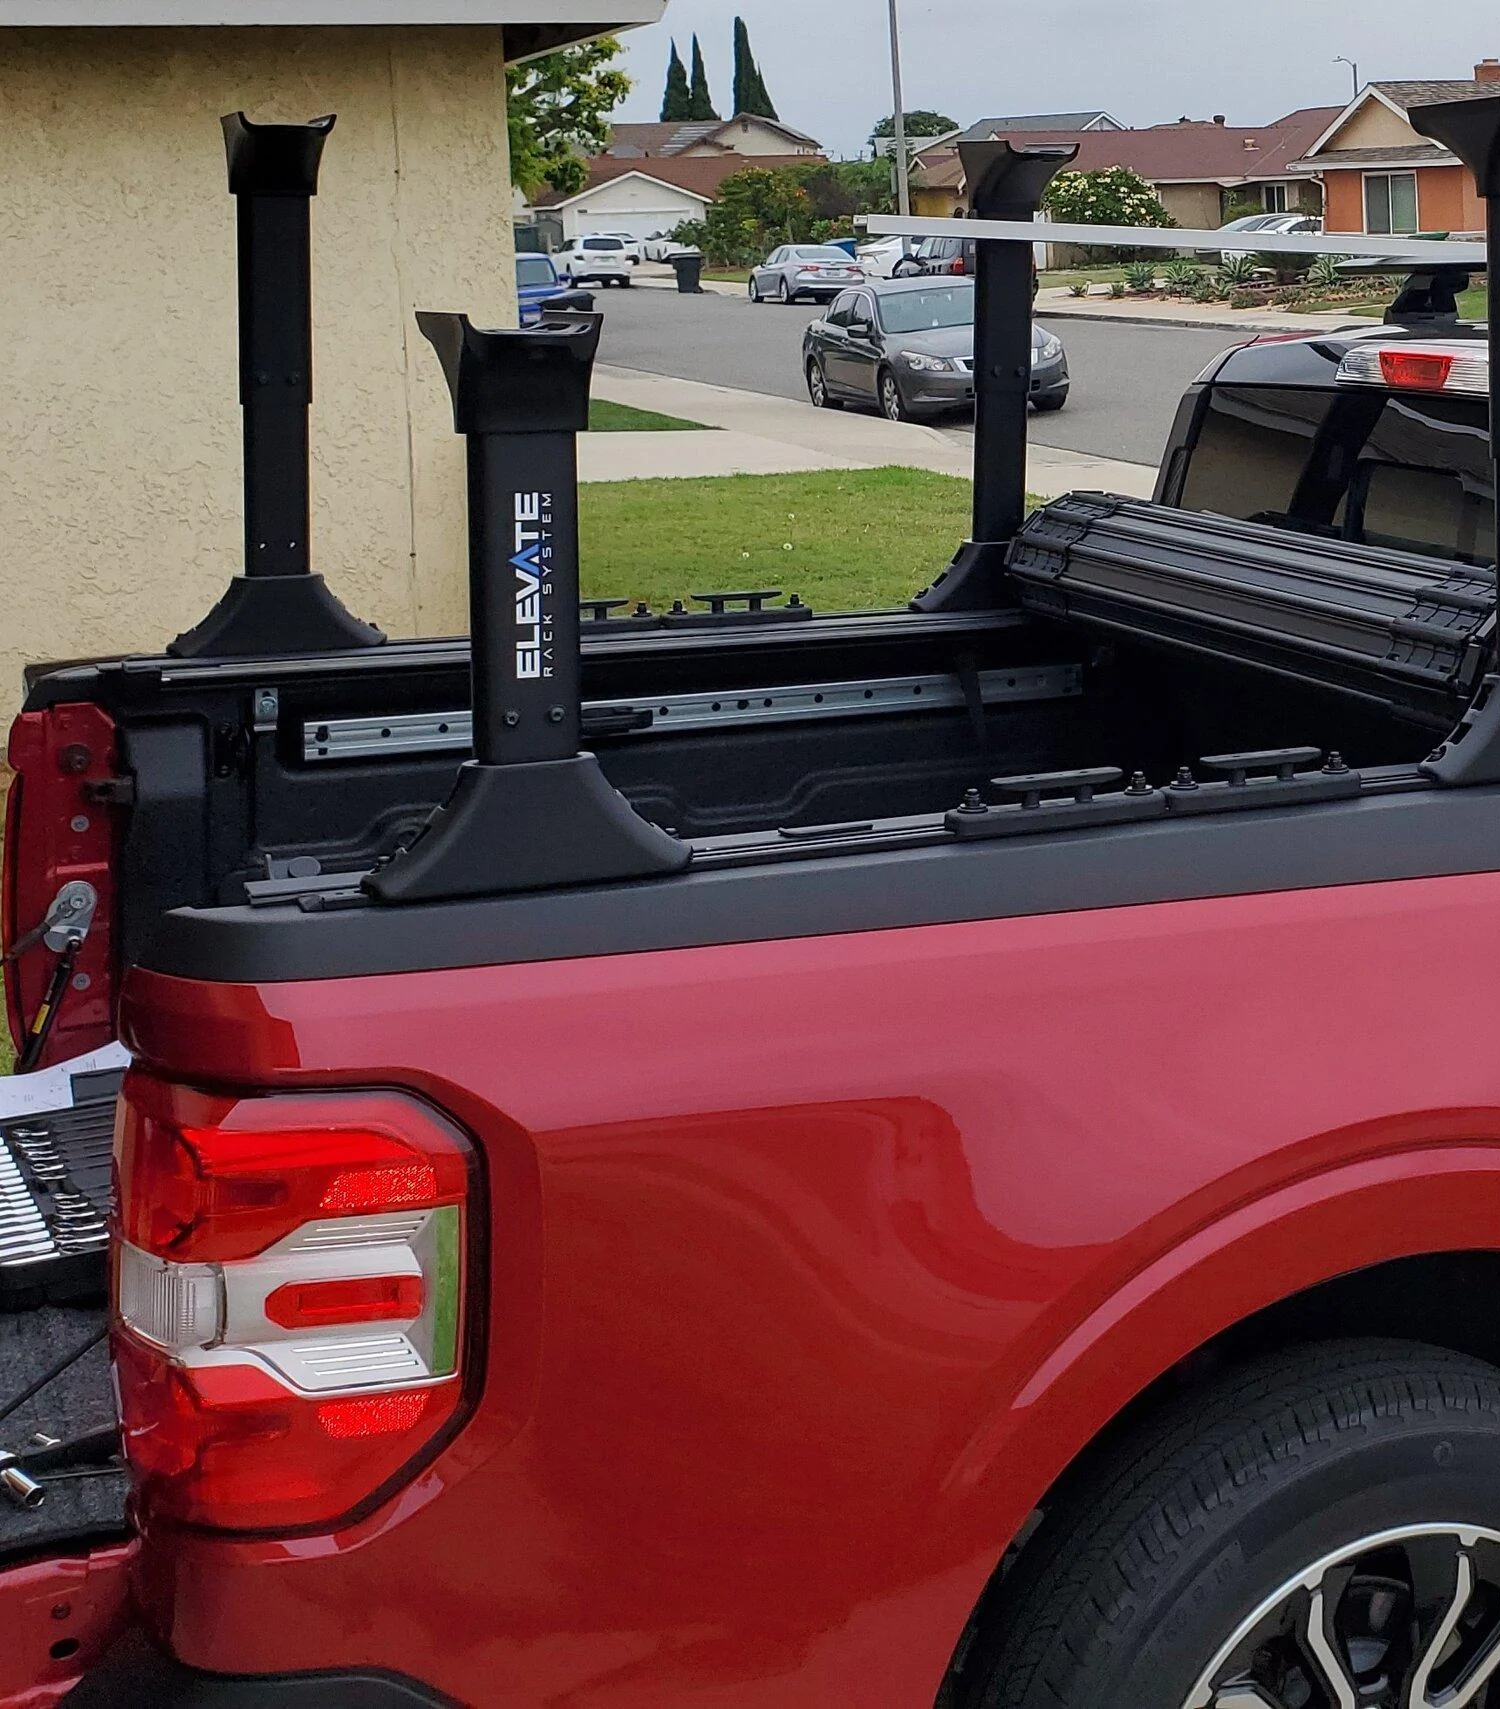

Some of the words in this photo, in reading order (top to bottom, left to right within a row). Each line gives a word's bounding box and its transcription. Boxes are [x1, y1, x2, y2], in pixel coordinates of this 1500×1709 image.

[508, 492, 541, 679] ELEVATE
[542, 493, 553, 595] SYSTEM
[543, 614, 554, 678] RACK
